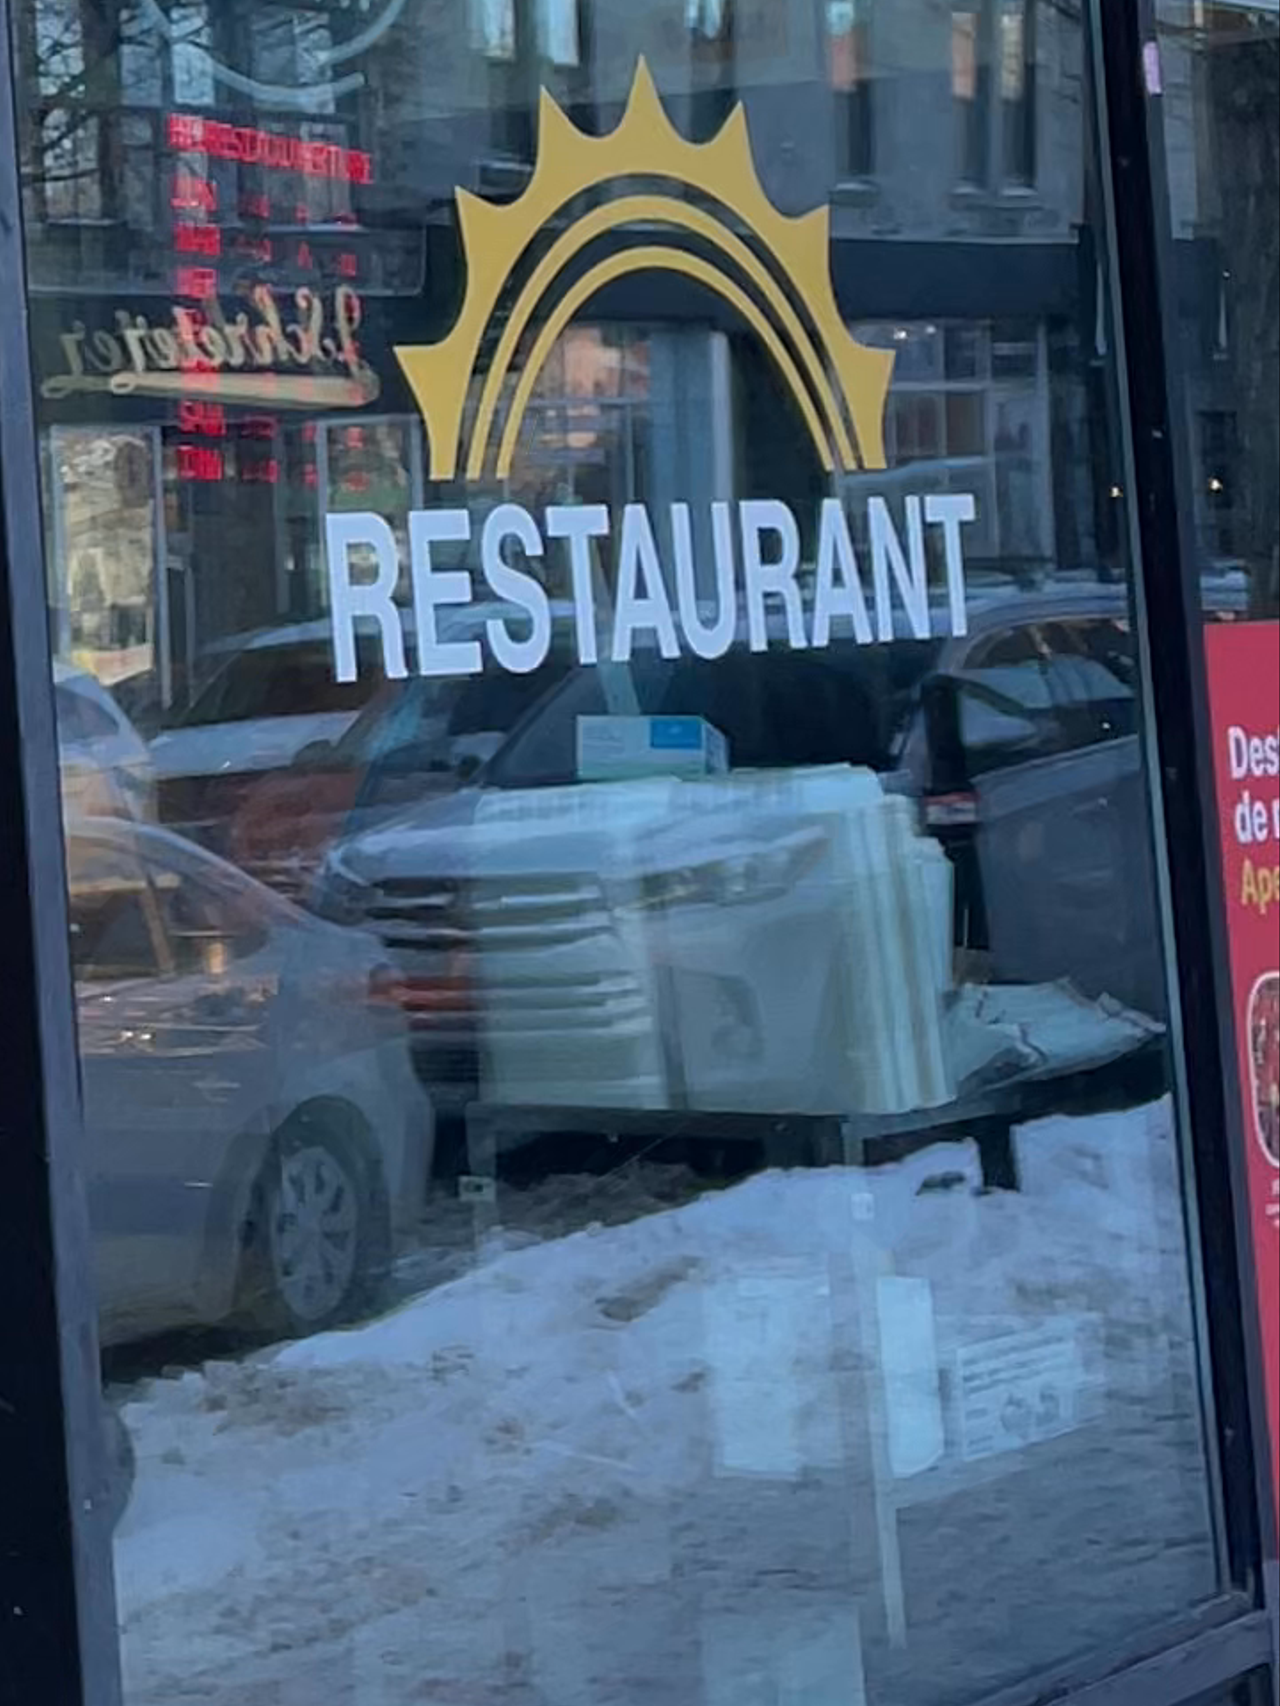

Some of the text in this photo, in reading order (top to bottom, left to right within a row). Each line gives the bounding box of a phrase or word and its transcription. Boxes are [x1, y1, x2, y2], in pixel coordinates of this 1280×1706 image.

[325, 492, 975, 683] RESTAURANT
[1228, 724, 1280, 779] Des
[1234, 790, 1269, 844] de
